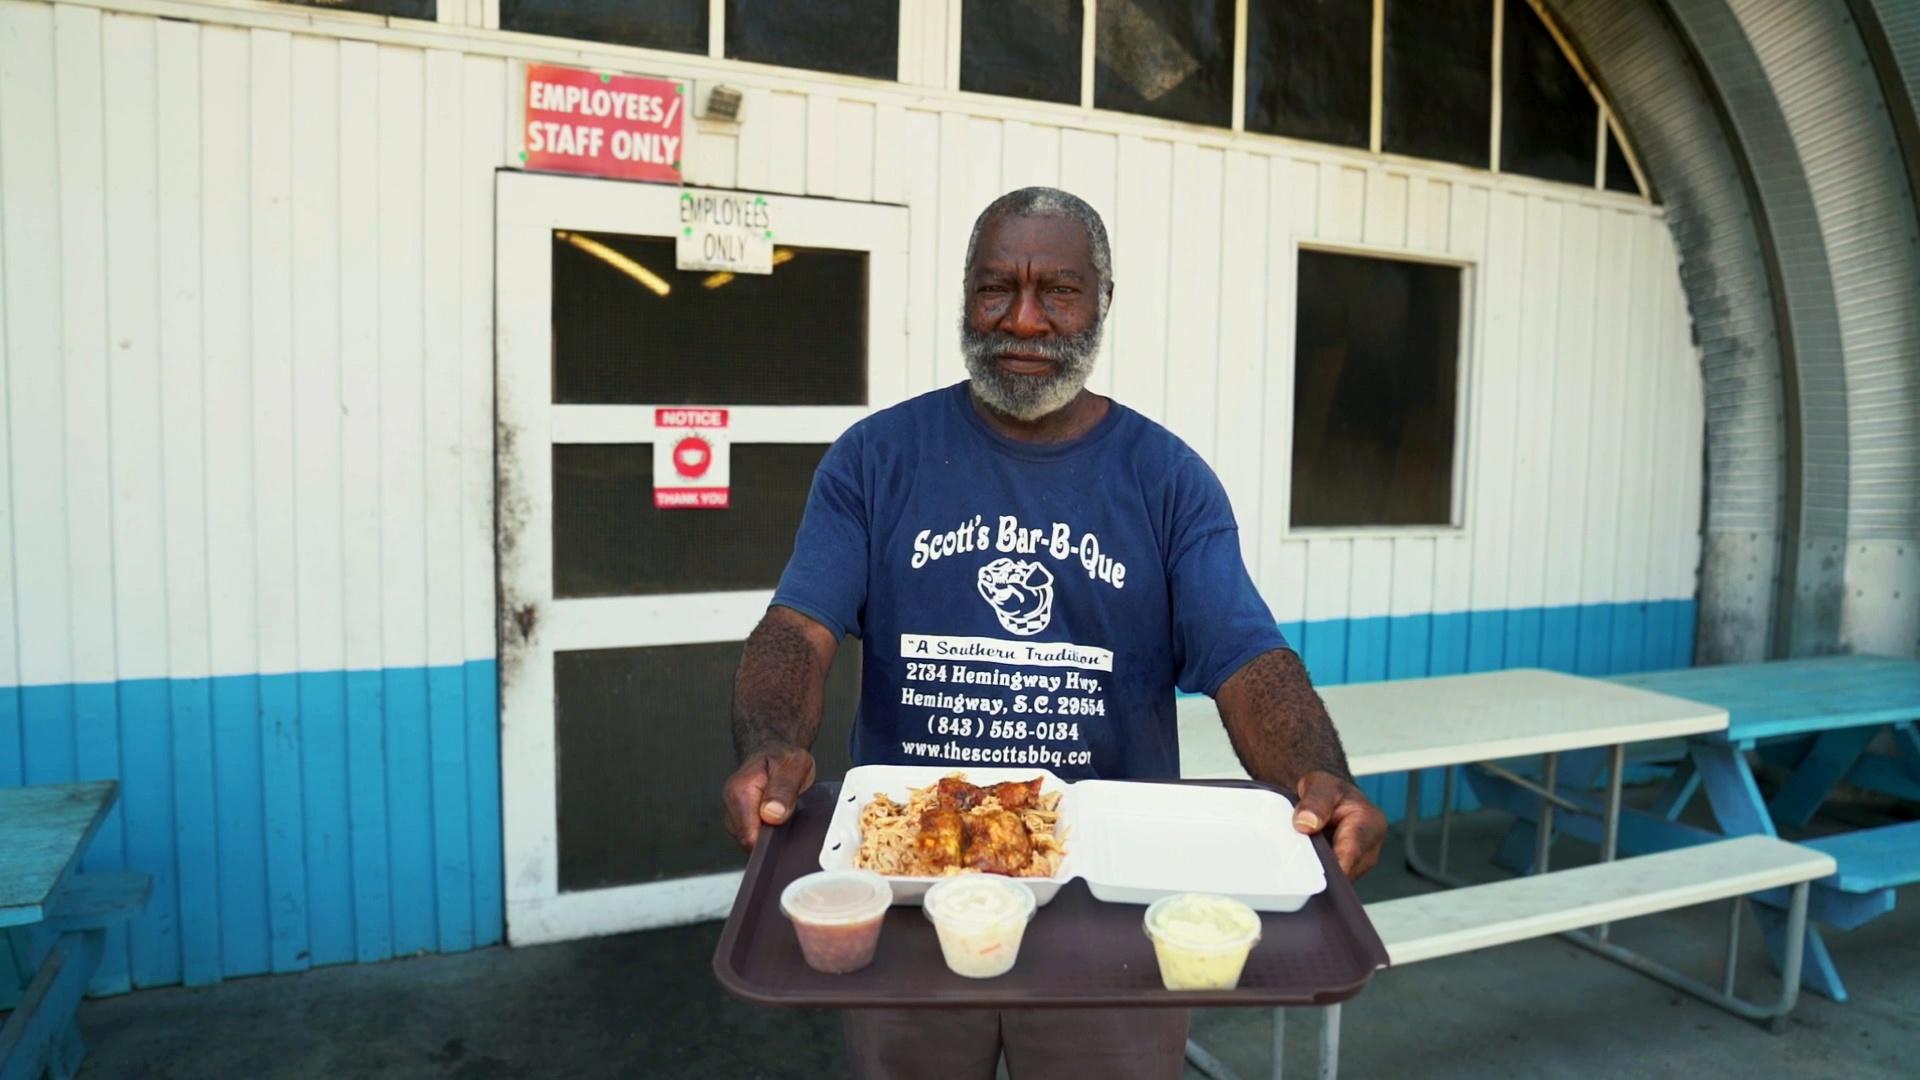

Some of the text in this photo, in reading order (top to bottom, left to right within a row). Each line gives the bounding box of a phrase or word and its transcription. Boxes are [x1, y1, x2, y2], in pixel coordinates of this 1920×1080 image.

[529, 82, 680, 129] EMPLOYEES/
[528, 121, 680, 165] STAFF ONLY
[680, 196, 770, 229] EMPLOYEES
[704, 233, 747, 262] ONLY
[662, 411, 721, 427] NOTICE
[657, 492, 728, 505] THANK YOU
[911, 514, 1126, 589] Scott's Bar-B-Que
[937, 641, 1015, 659] Southern
[906, 662, 1103, 694] 2734 Hemingway Hwy.
[901, 688, 1105, 716] Hemingway, S.C. 29554
[989, 719, 1079, 740] 558-0134
